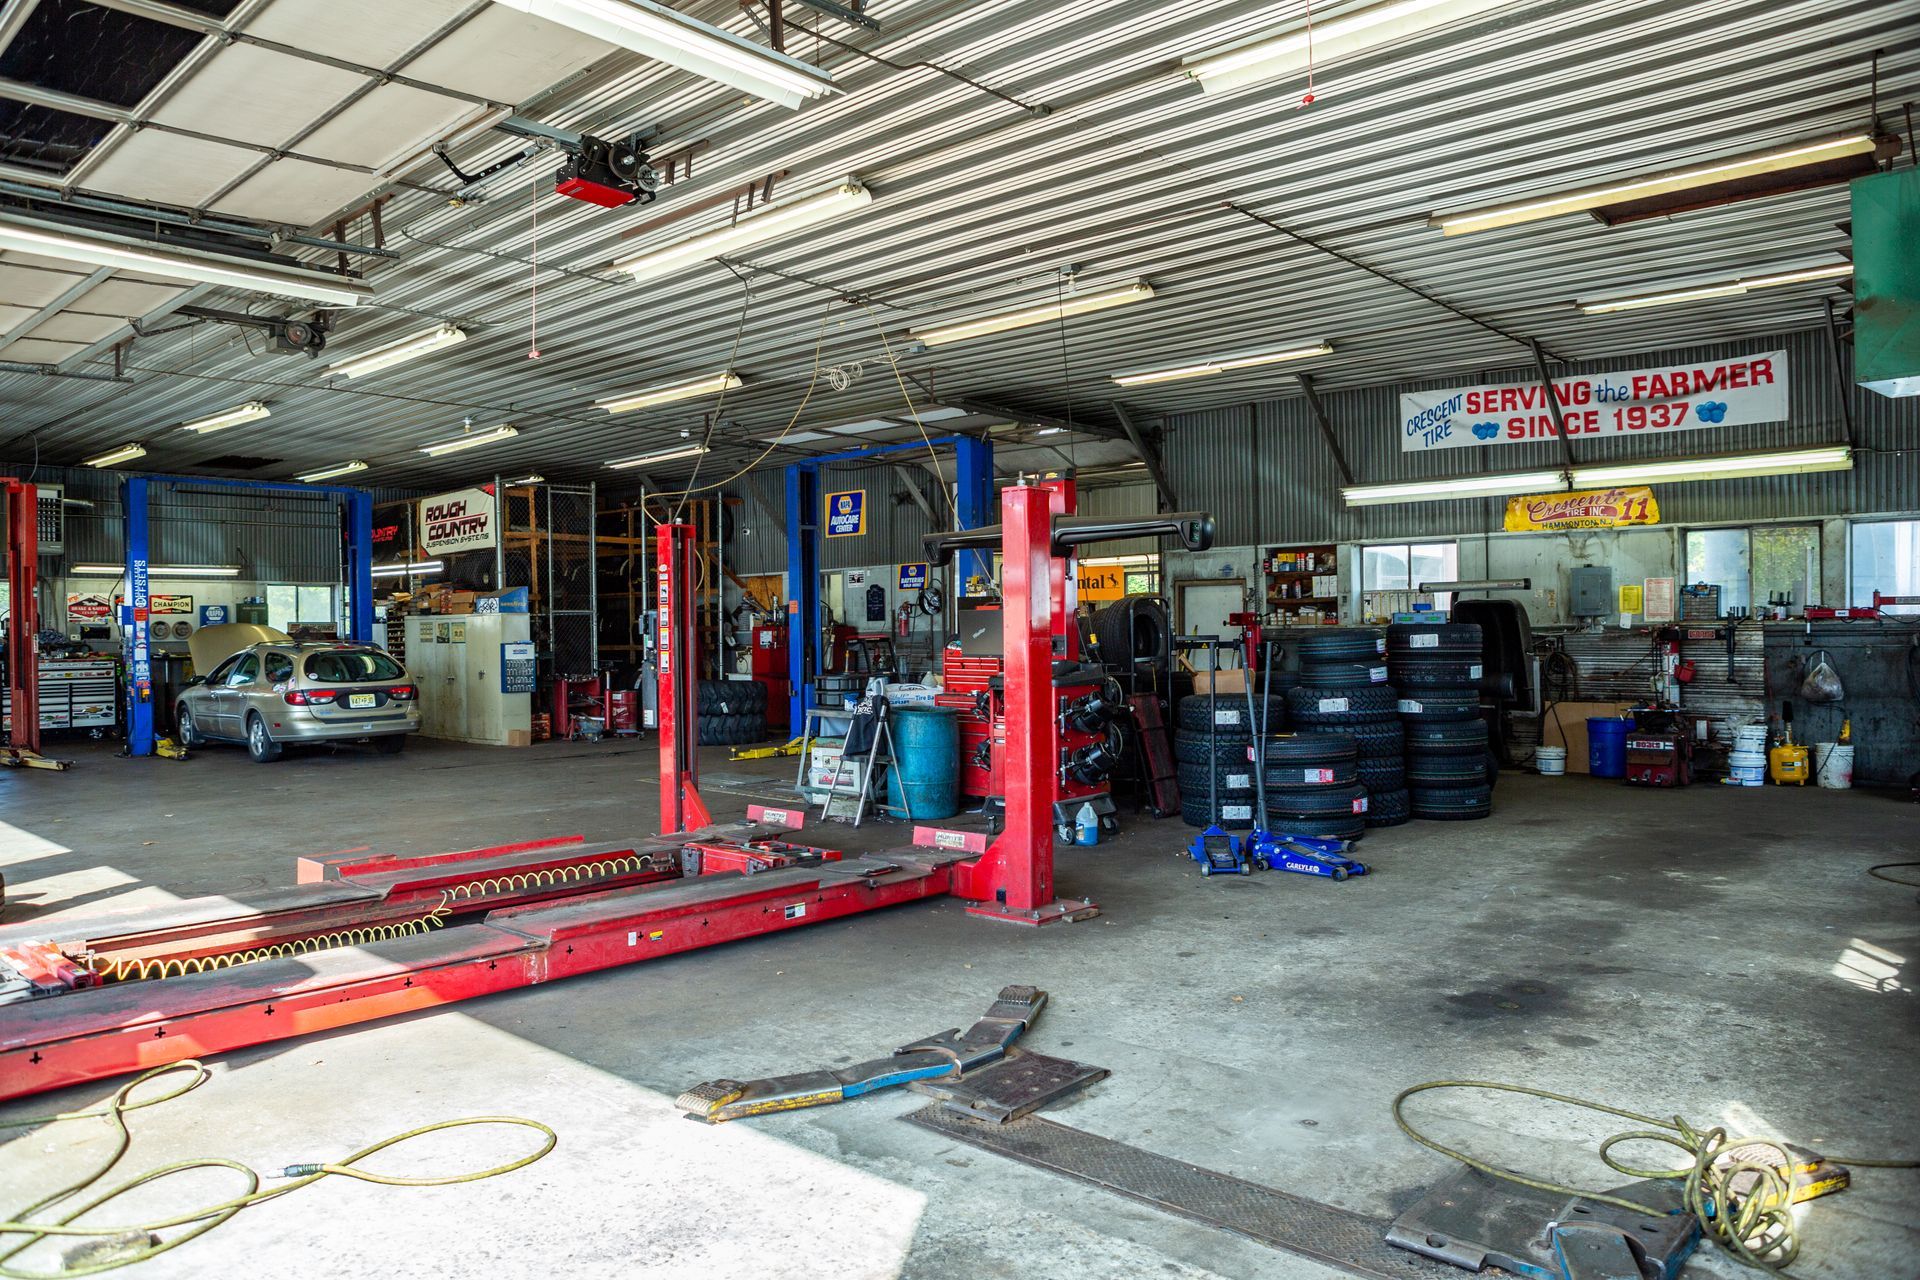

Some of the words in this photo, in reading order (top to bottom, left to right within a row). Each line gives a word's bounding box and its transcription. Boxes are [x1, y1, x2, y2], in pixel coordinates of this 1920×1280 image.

[1466, 381, 1591, 414] SERVING
[1595, 379, 1630, 403] the
[1632, 358, 1774, 400] FARMER
[1407, 394, 1463, 436] CRESCENT
[1507, 410, 1600, 439] SINCE
[1613, 402, 1689, 431] 1937
[1423, 419, 1452, 448] TIRE
[425, 500, 466, 522] ROUGH
[1527, 489, 1625, 521] Crescent
[1619, 498, 1649, 520] 11
[1565, 507, 1585, 517] TIRE
[1589, 506, 1607, 516] INC.
[428, 516, 487, 540] COUNTRY
[836, 525, 853, 533] CENTER
[426, 538, 459, 549] SUSPENSION
[460, 533, 489, 543] SYSTEMS
[1077, 574, 1105, 589] ntal
[1286, 861, 1313, 872] CARLYLE
